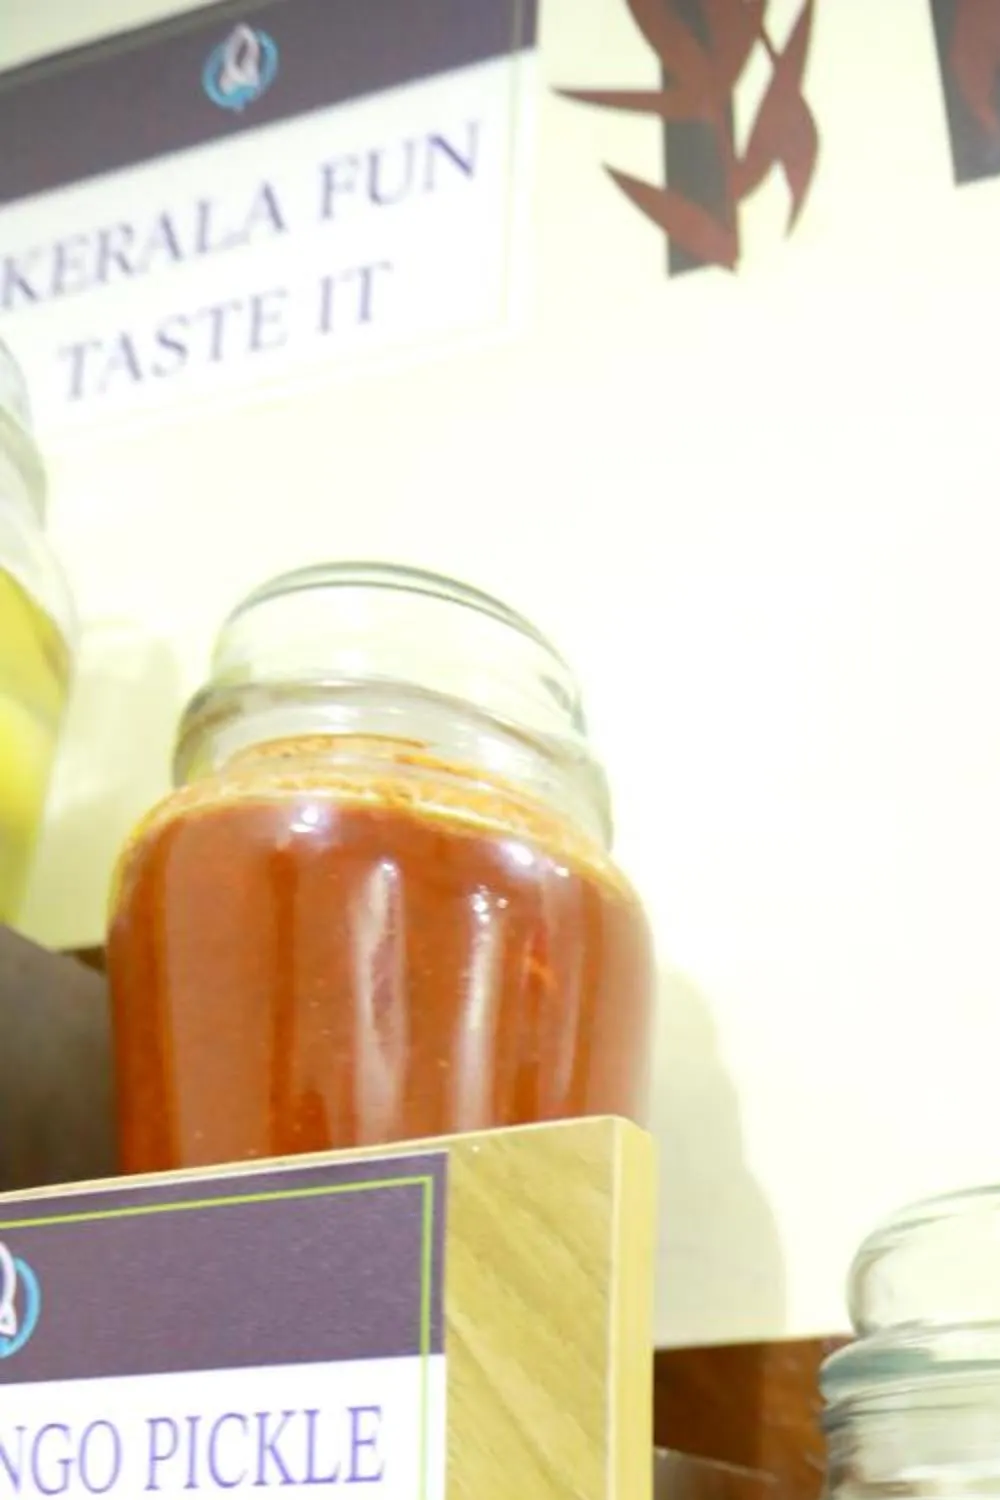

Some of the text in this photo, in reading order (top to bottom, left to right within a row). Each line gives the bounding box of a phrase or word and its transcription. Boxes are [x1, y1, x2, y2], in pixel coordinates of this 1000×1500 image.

[0, 120, 481, 312] KERALA FUN
[57, 260, 393, 401] TASTE IT
[144, 1405, 386, 1492] PICKLE
